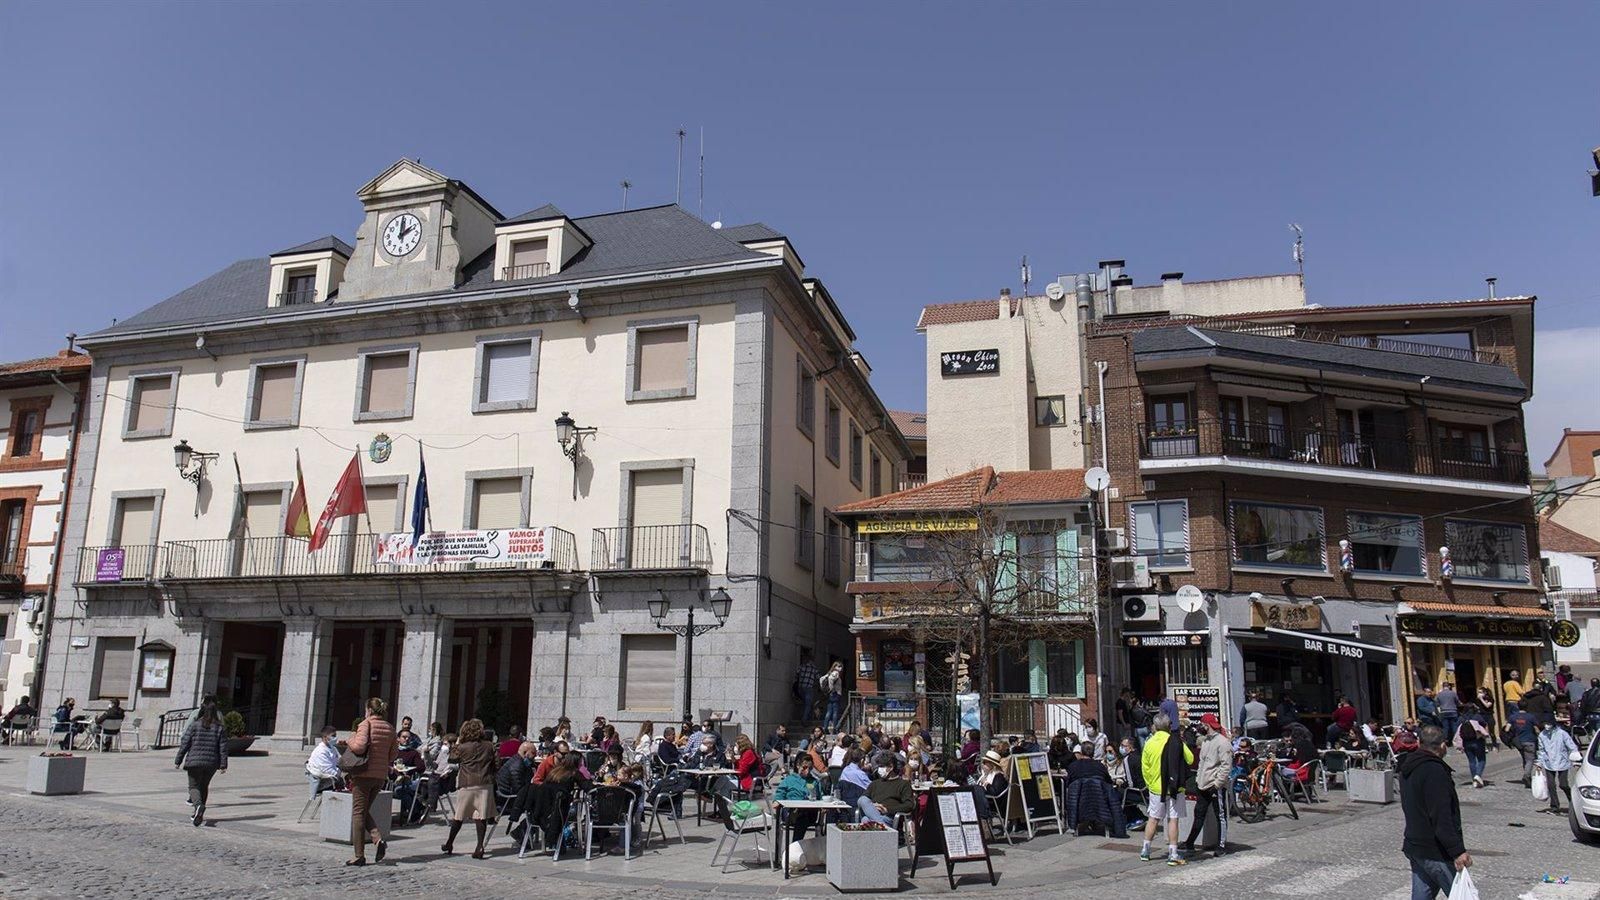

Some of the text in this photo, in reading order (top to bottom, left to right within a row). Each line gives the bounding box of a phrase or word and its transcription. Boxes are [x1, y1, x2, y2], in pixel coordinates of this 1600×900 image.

[976, 361, 995, 371] Loco
[865, 519, 971, 532] AGENCIA DE VIAJES
[508, 530, 537, 538] VAMOS
[507, 544, 544, 553] JUNTOS
[1401, 618, 1424, 630] Café
[1489, 622, 1498, 631] El
[1142, 636, 1187, 646] HAMBURGUESAS
[1304, 639, 1363, 658] BAR EL PASO
